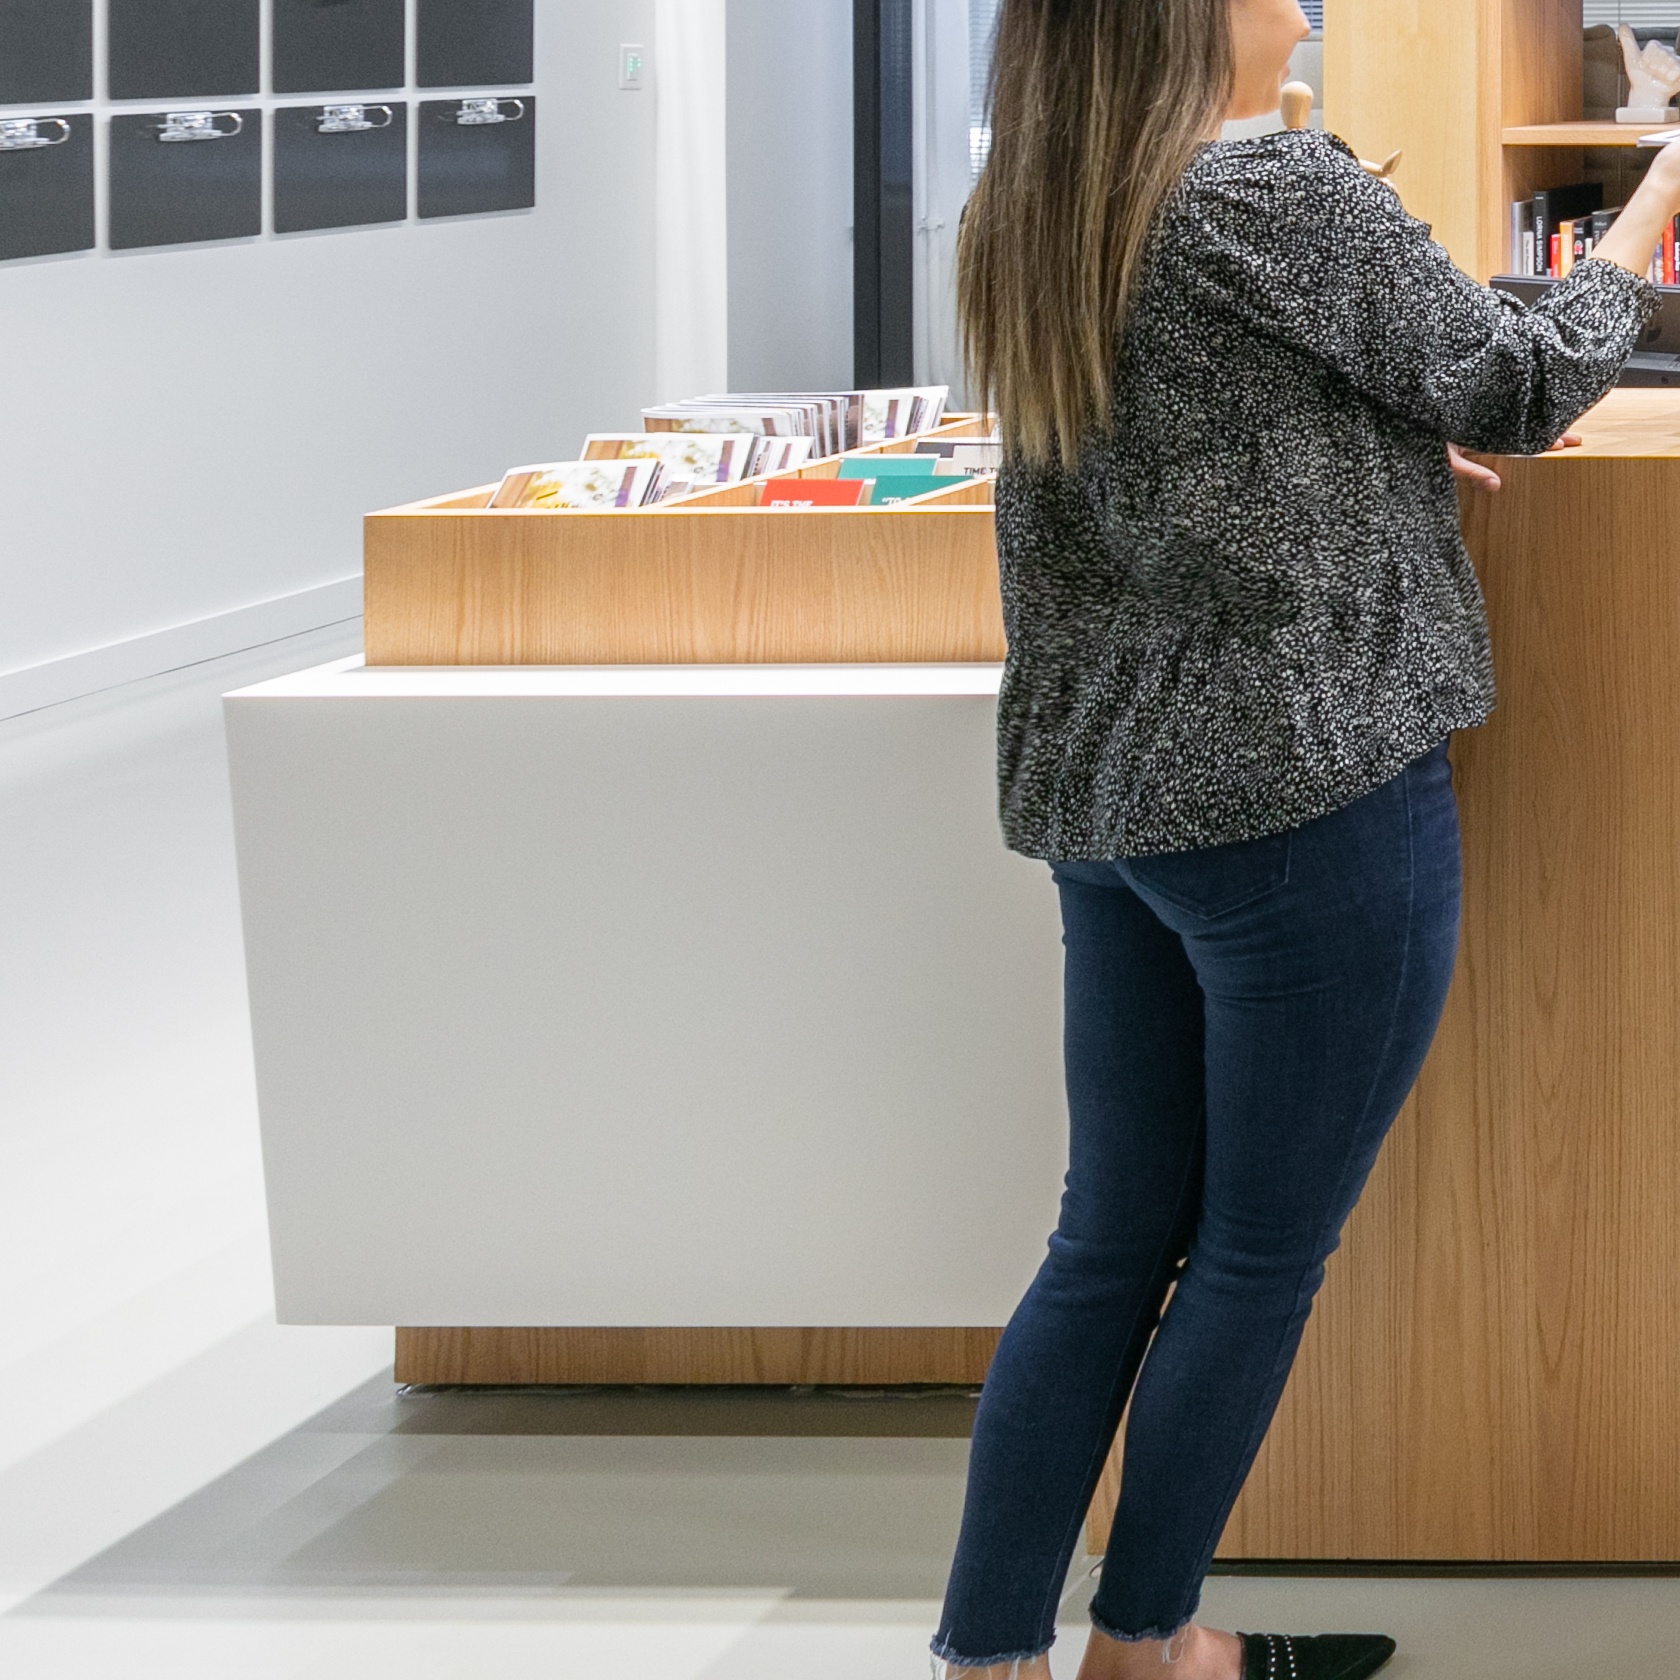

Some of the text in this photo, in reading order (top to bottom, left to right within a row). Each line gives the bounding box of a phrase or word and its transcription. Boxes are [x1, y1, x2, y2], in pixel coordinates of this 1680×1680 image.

[1535, 216, 1544, 272] LORNA SIMPSON
[964, 467, 987, 476] TIME
